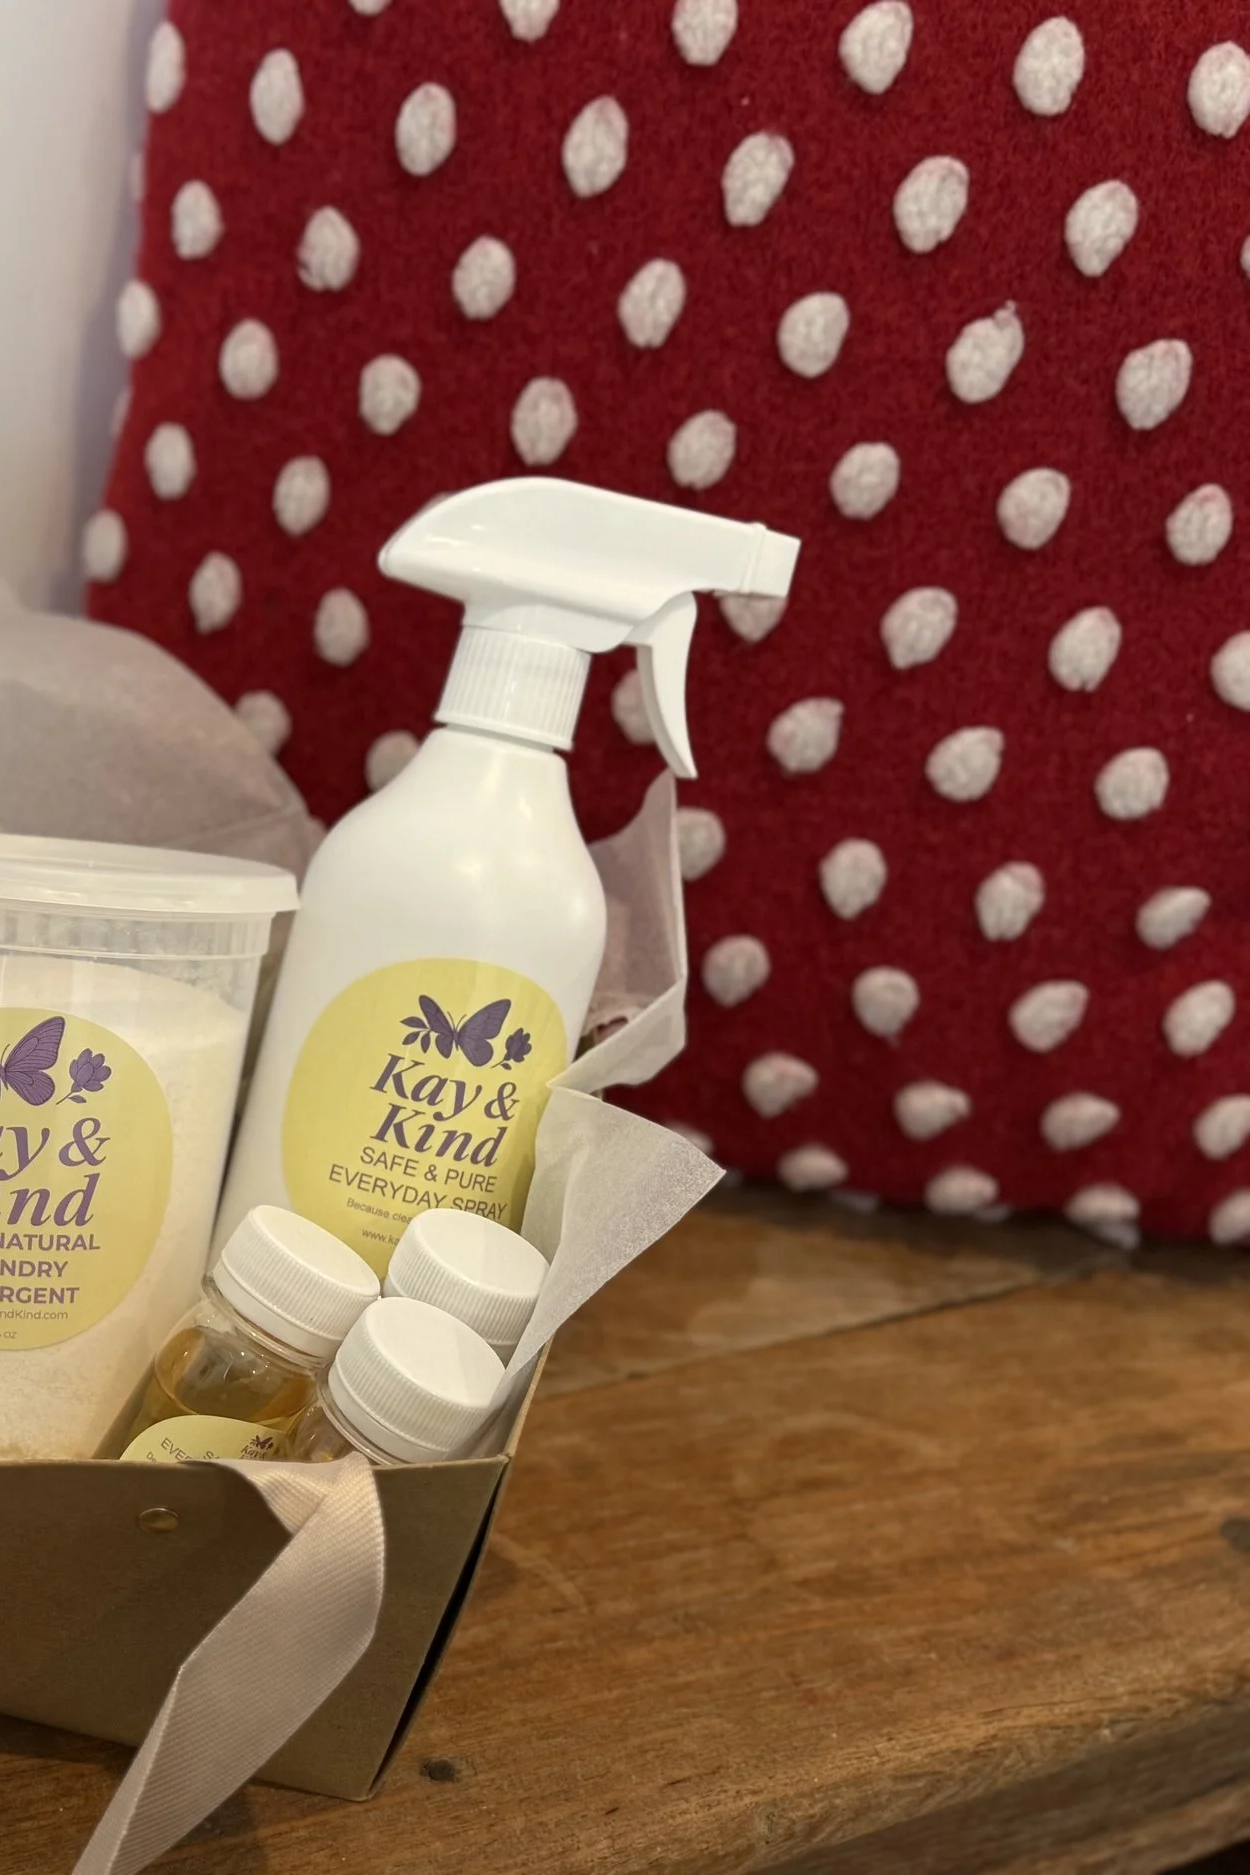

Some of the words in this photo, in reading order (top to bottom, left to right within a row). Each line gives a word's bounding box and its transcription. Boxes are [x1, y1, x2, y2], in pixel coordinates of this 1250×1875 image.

[370, 1052, 483, 1122] Kay
[483, 1081, 520, 1121] &
[58, 1117, 111, 1167] &
[370, 1102, 508, 1168] Kind
[329, 1163, 448, 1210] EVERYDAY
[360, 1146, 420, 1178] SAFE
[423, 1163, 438, 1182] &
[444, 1168, 498, 1194] PURE
[346, 1197, 390, 1220] Because
[392, 1210, 413, 1225] clea
[361, 1228, 400, 1246] www.ka
[3, 1330, 17, 1339] OZ
